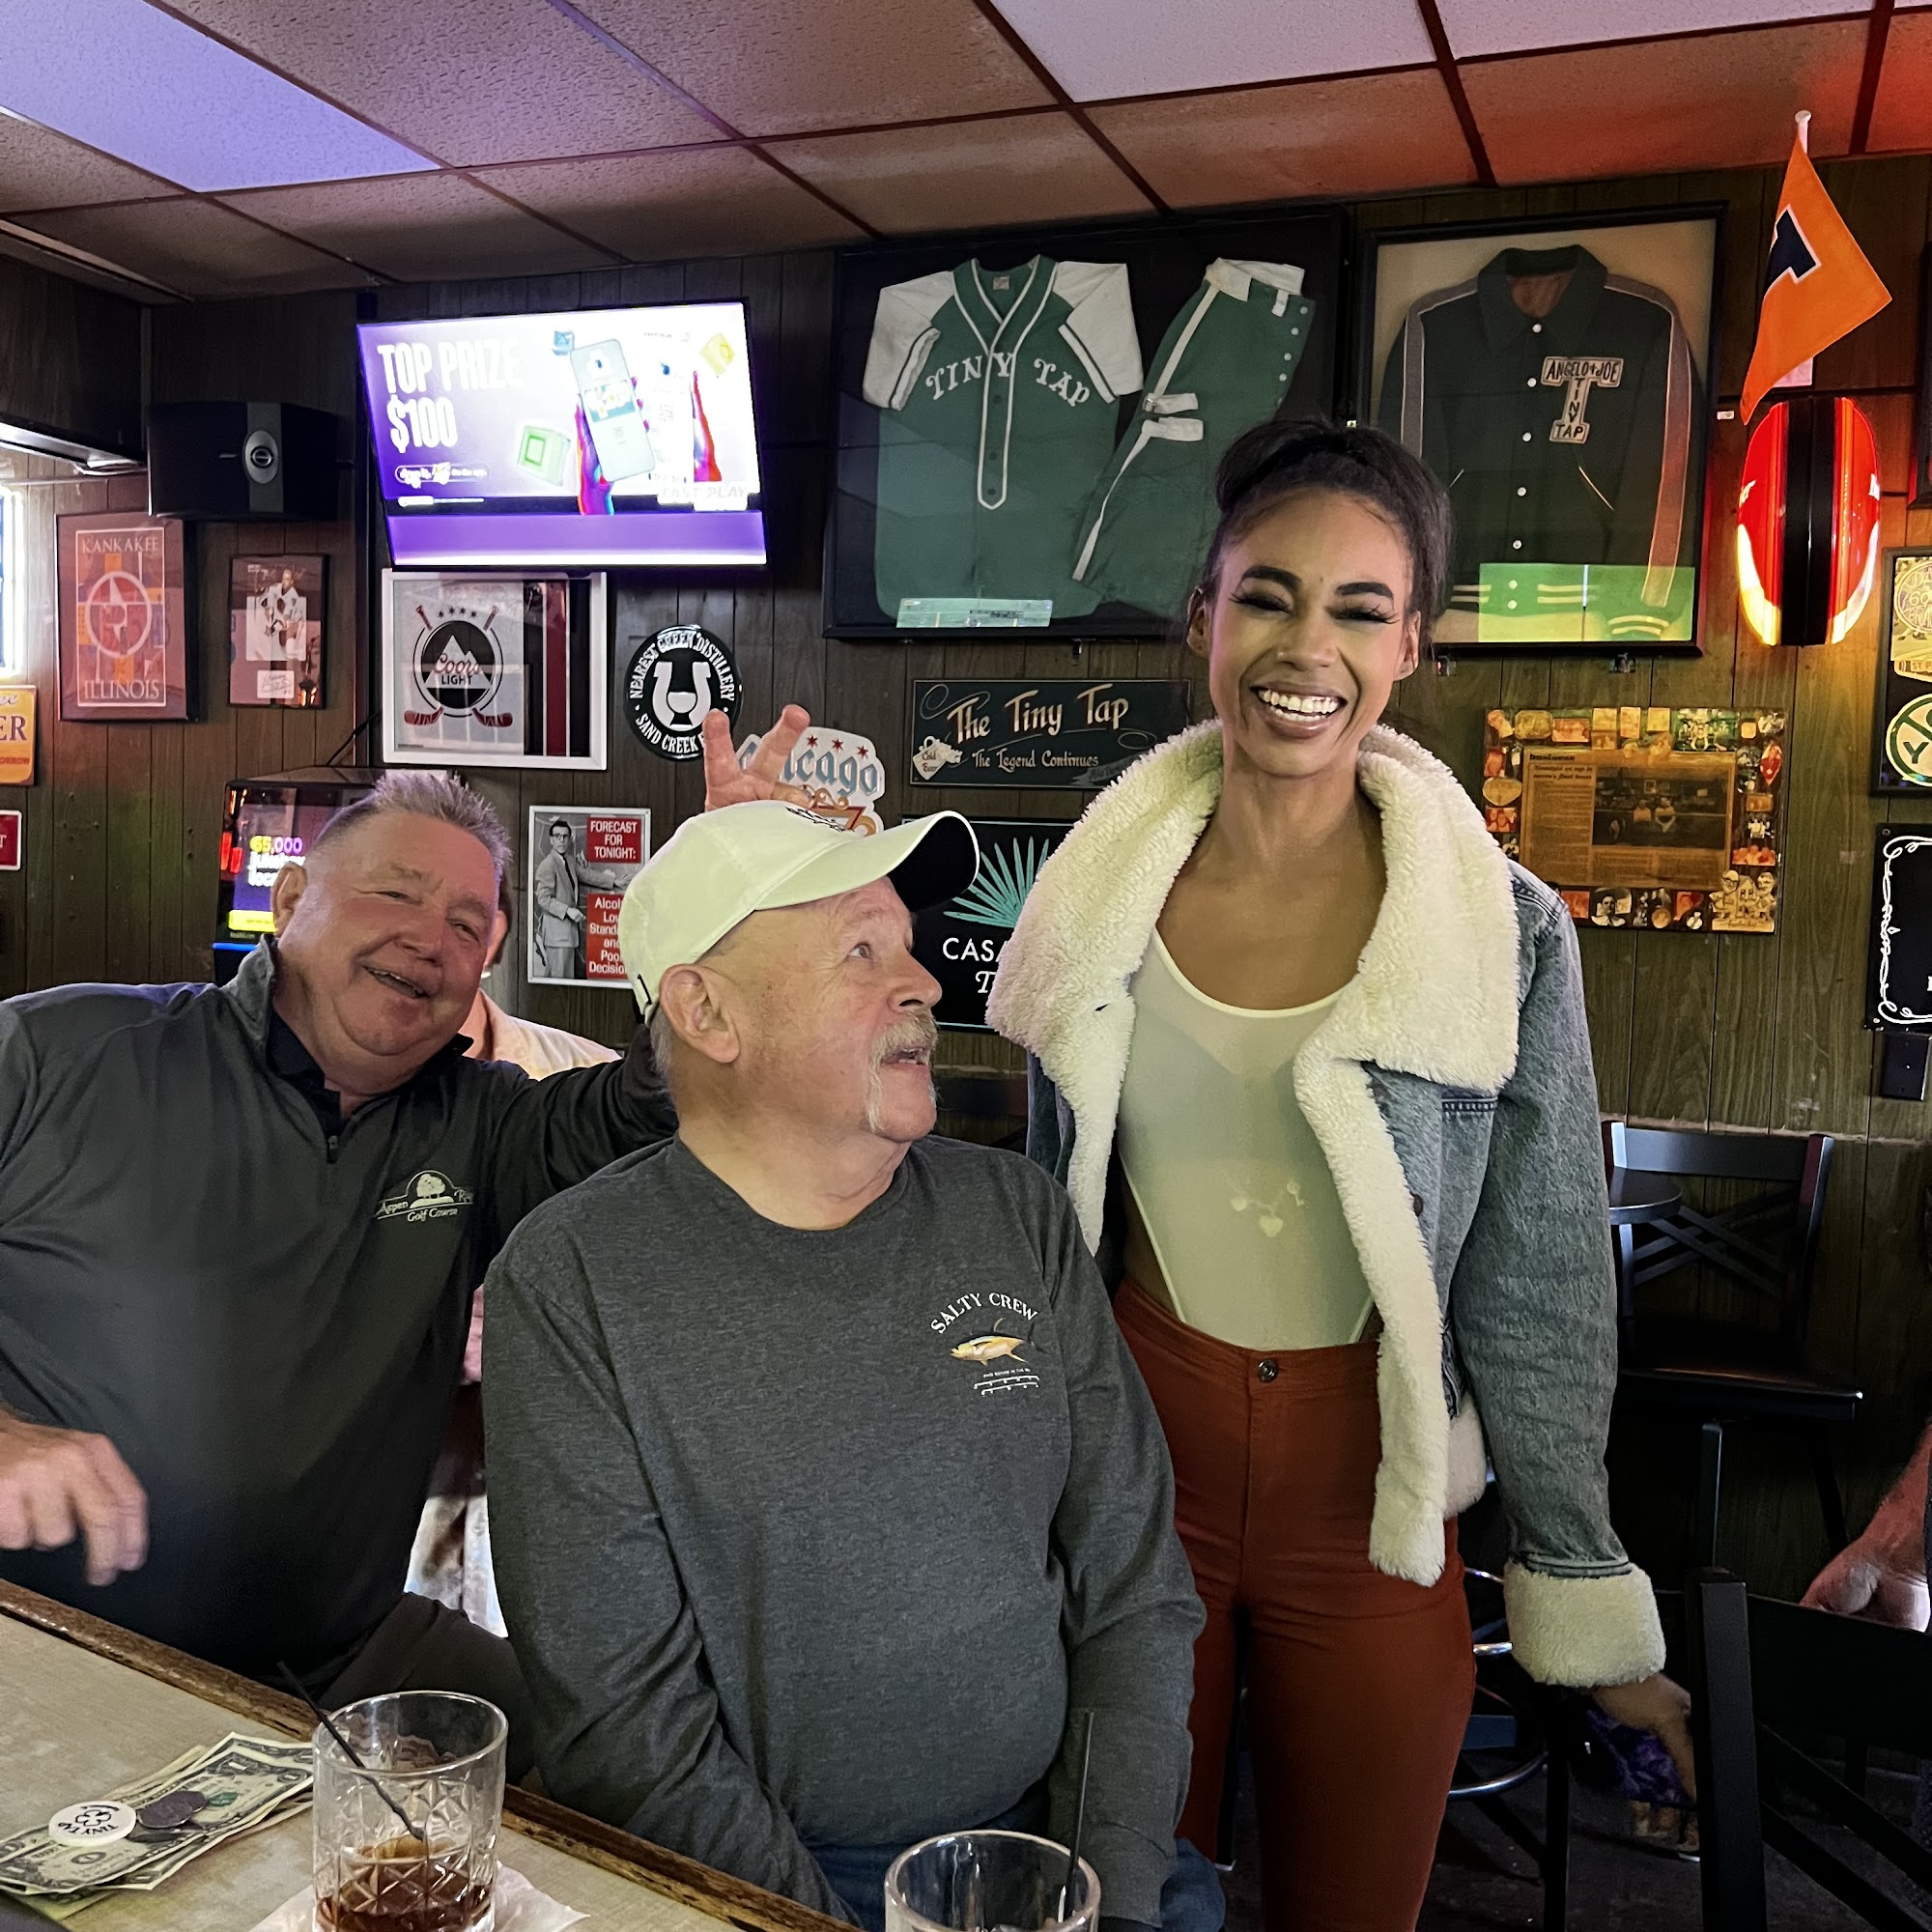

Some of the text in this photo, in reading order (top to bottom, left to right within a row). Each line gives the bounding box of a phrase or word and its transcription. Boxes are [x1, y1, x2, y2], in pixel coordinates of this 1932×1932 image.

[377, 339, 524, 394] TOP PRIZE
[925, 353, 1091, 407] TINY TAP
[1568, 378, 1584, 423] TINY
[387, 394, 458, 454] $100
[1556, 425, 1583, 438] TAP
[82, 536, 159, 553] KANKAKEE
[434, 652, 483, 676] Coors
[630, 630, 735, 701] NEAREST GREEN DISTILLERY
[84, 680, 159, 699] ILLINOIS
[441, 675, 472, 686] LIGHT
[947, 683, 1129, 744] The Tiny Tap
[636, 713, 662, 745] SAND
[661, 734, 699, 754] CREEK
[972, 748, 1099, 773] The Legend Continues
[590, 821, 638, 834] FORECAST
[604, 834, 623, 845] FOR
[594, 847, 637, 860] TONIGHT:
[589, 923, 618, 935] Stand
[601, 950, 620, 961] Poo
[942, 937, 1000, 963] CAS
[589, 961, 627, 974] Decisio
[408, 1208, 459, 1222] Golf Course
[930, 1292, 1038, 1334] SALTY CREW
